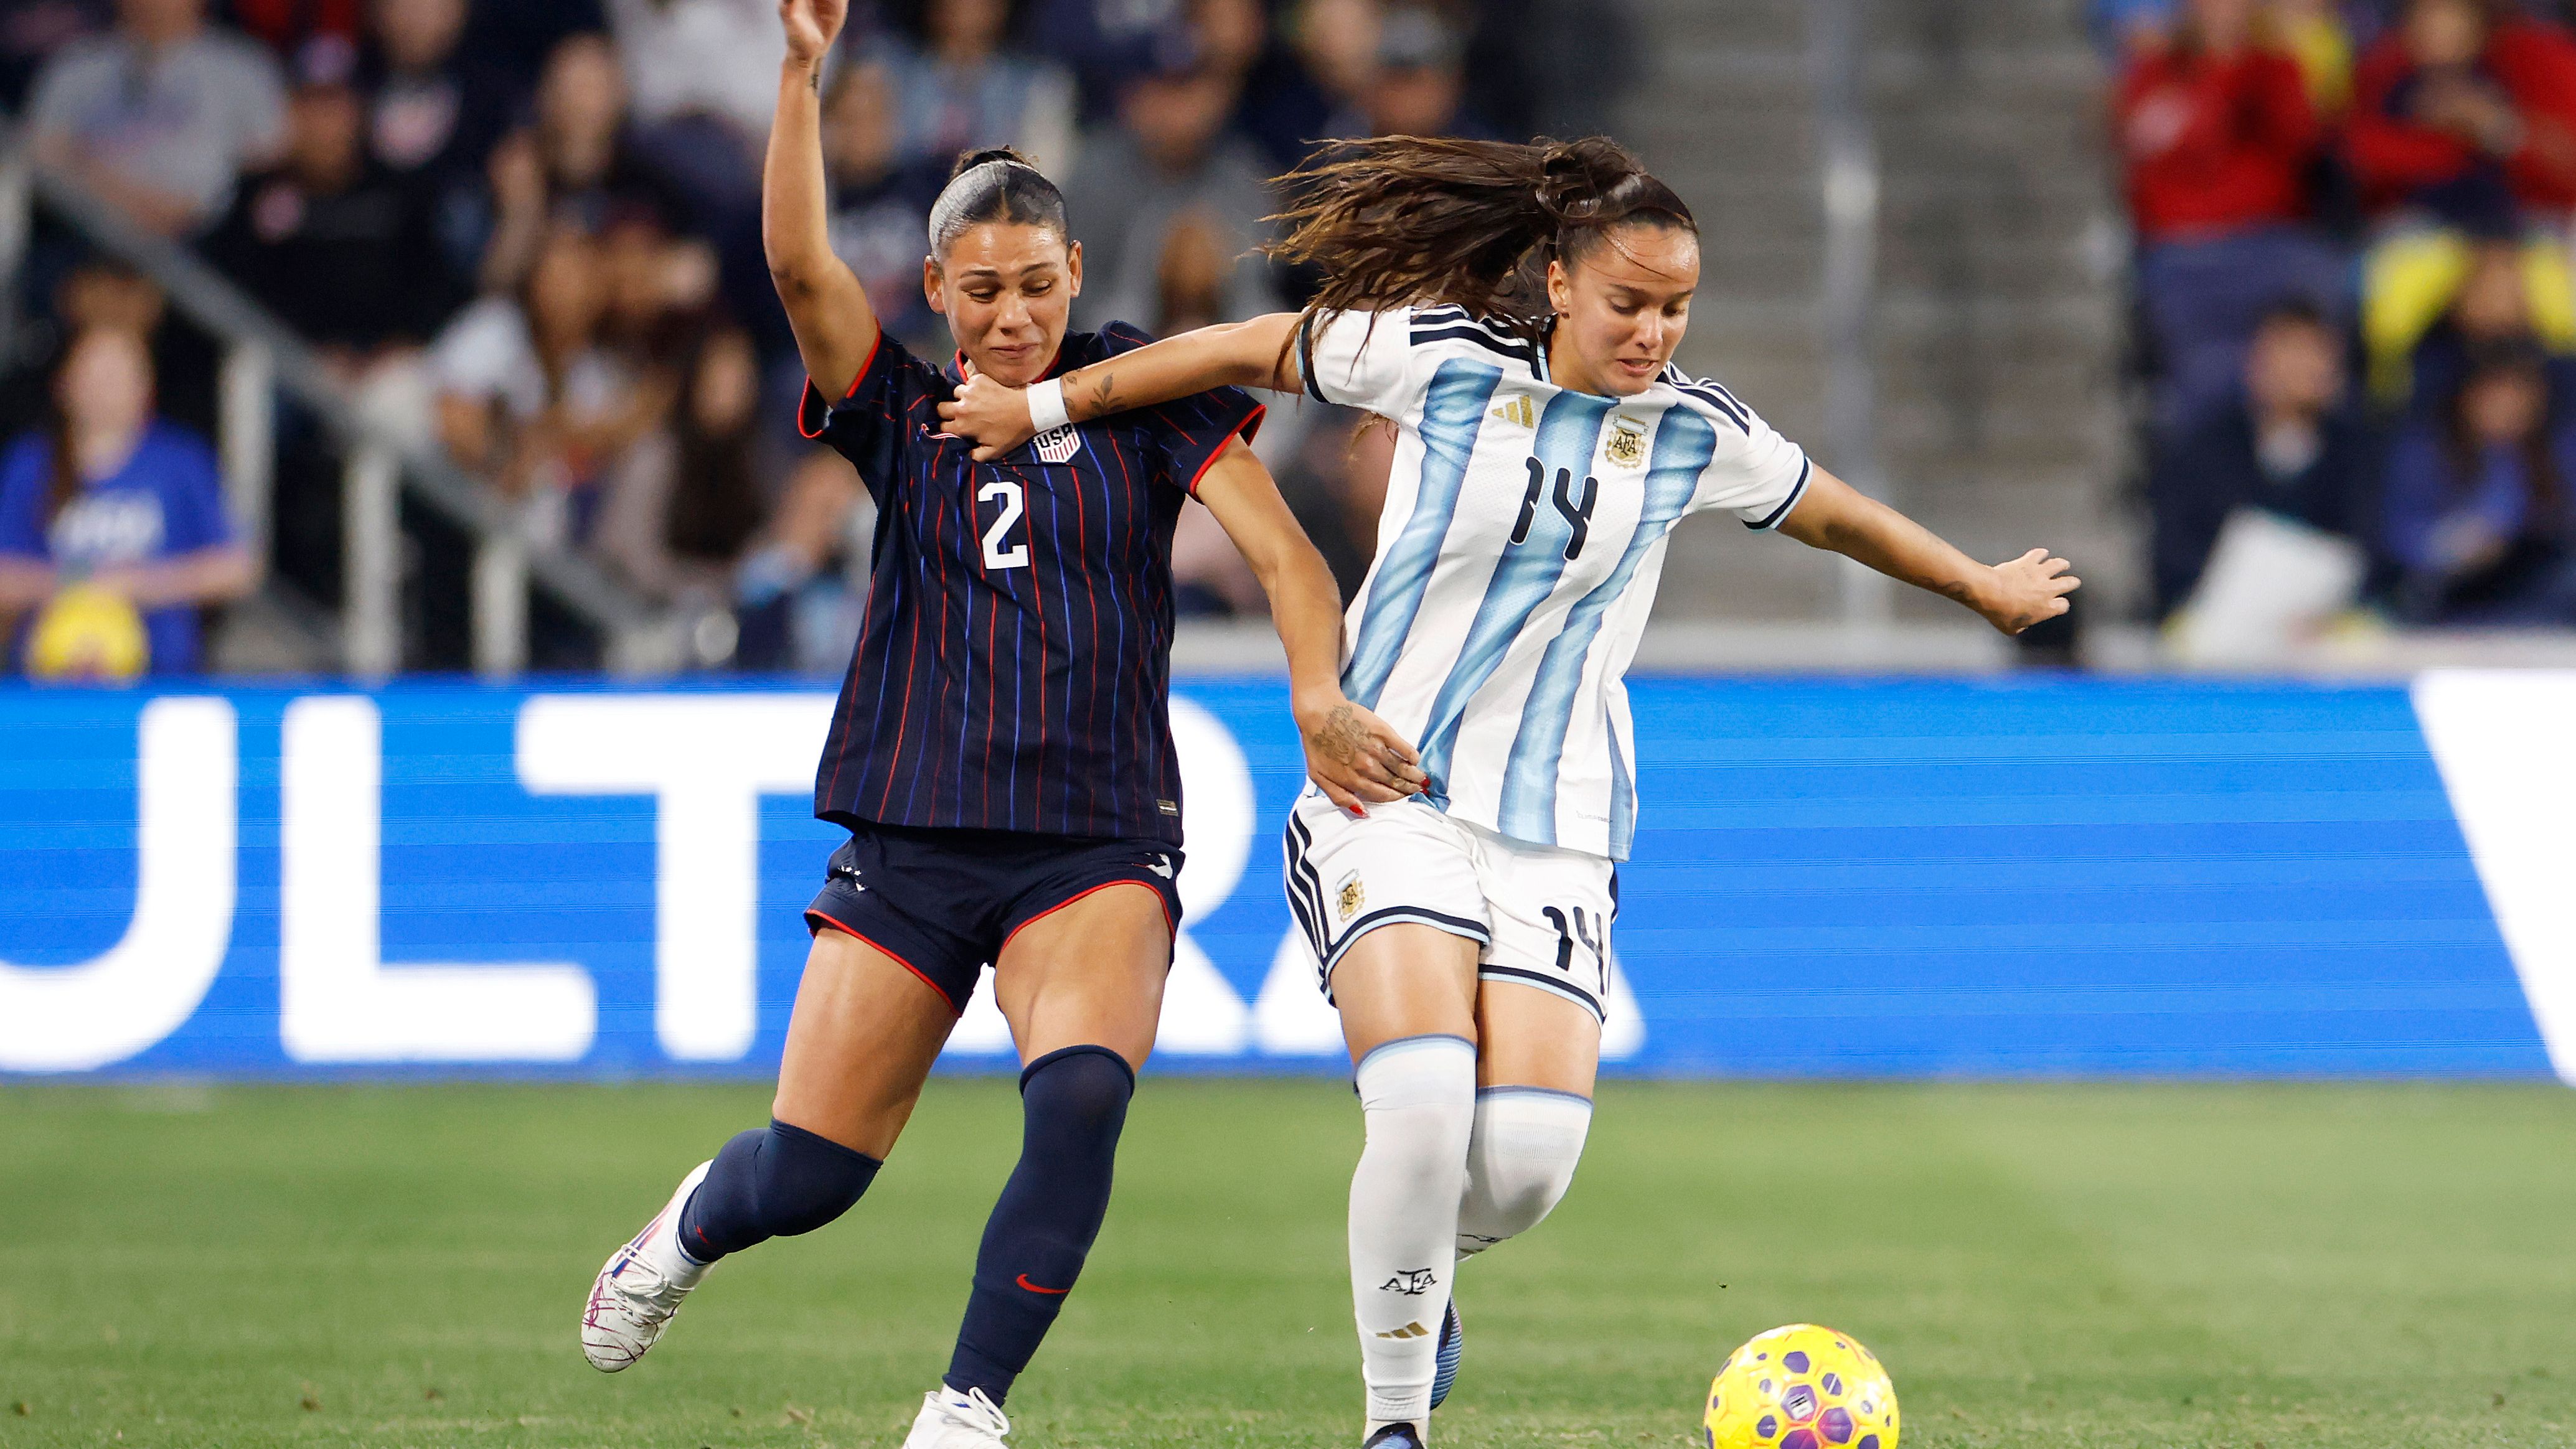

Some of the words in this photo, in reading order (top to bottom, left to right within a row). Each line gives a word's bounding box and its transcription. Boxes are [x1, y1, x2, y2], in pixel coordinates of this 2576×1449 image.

[1037, 422, 1073, 449] USA
[1614, 429, 1637, 456] AFA
[977, 481, 1029, 570] 2
[1510, 456, 1598, 561] 14
[0, 693, 1648, 1073] ULT
[1541, 906, 1605, 996] 14
[1378, 1267, 1438, 1296] AFA
